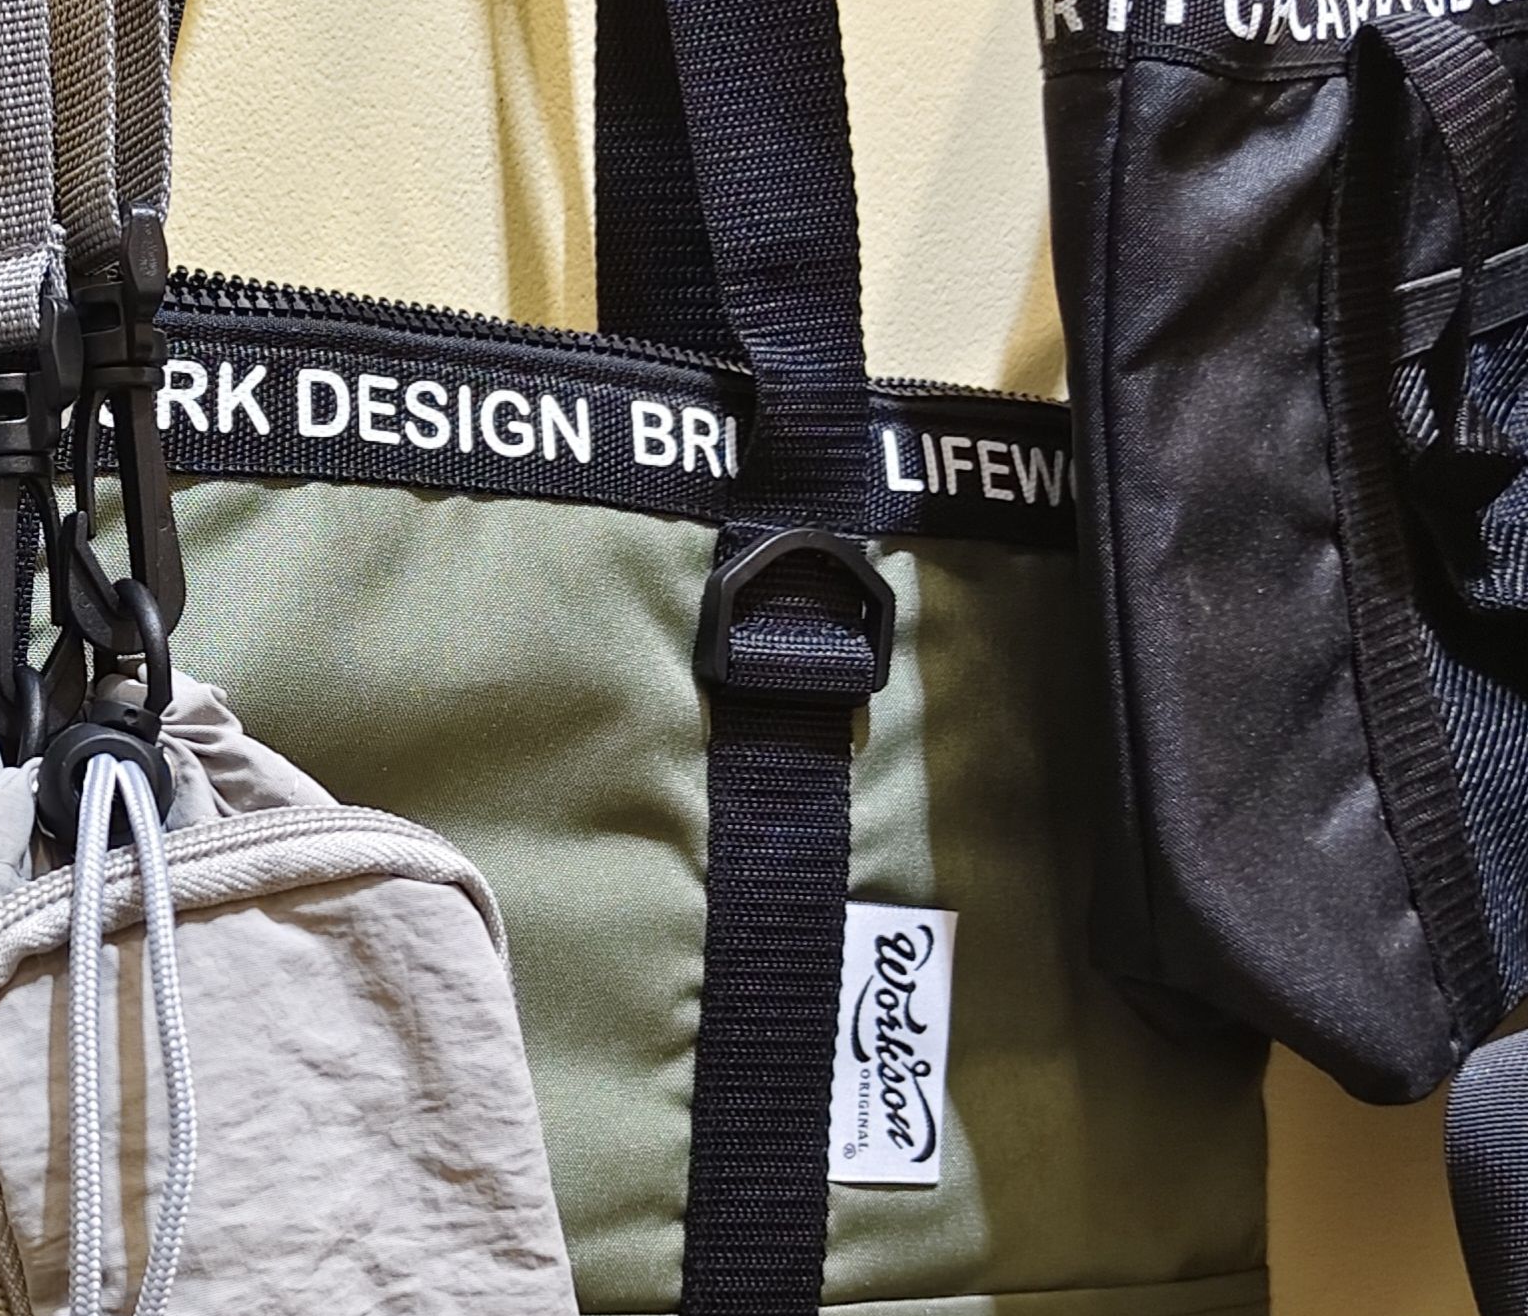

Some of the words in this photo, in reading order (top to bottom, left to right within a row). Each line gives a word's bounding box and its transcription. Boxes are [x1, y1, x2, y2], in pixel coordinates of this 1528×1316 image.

[100, 359, 271, 437] RK
[295, 367, 593, 465] DESIGN
[882, 428, 1074, 509] LIFEW
[856, 1067, 872, 1153] ORIGINAL
